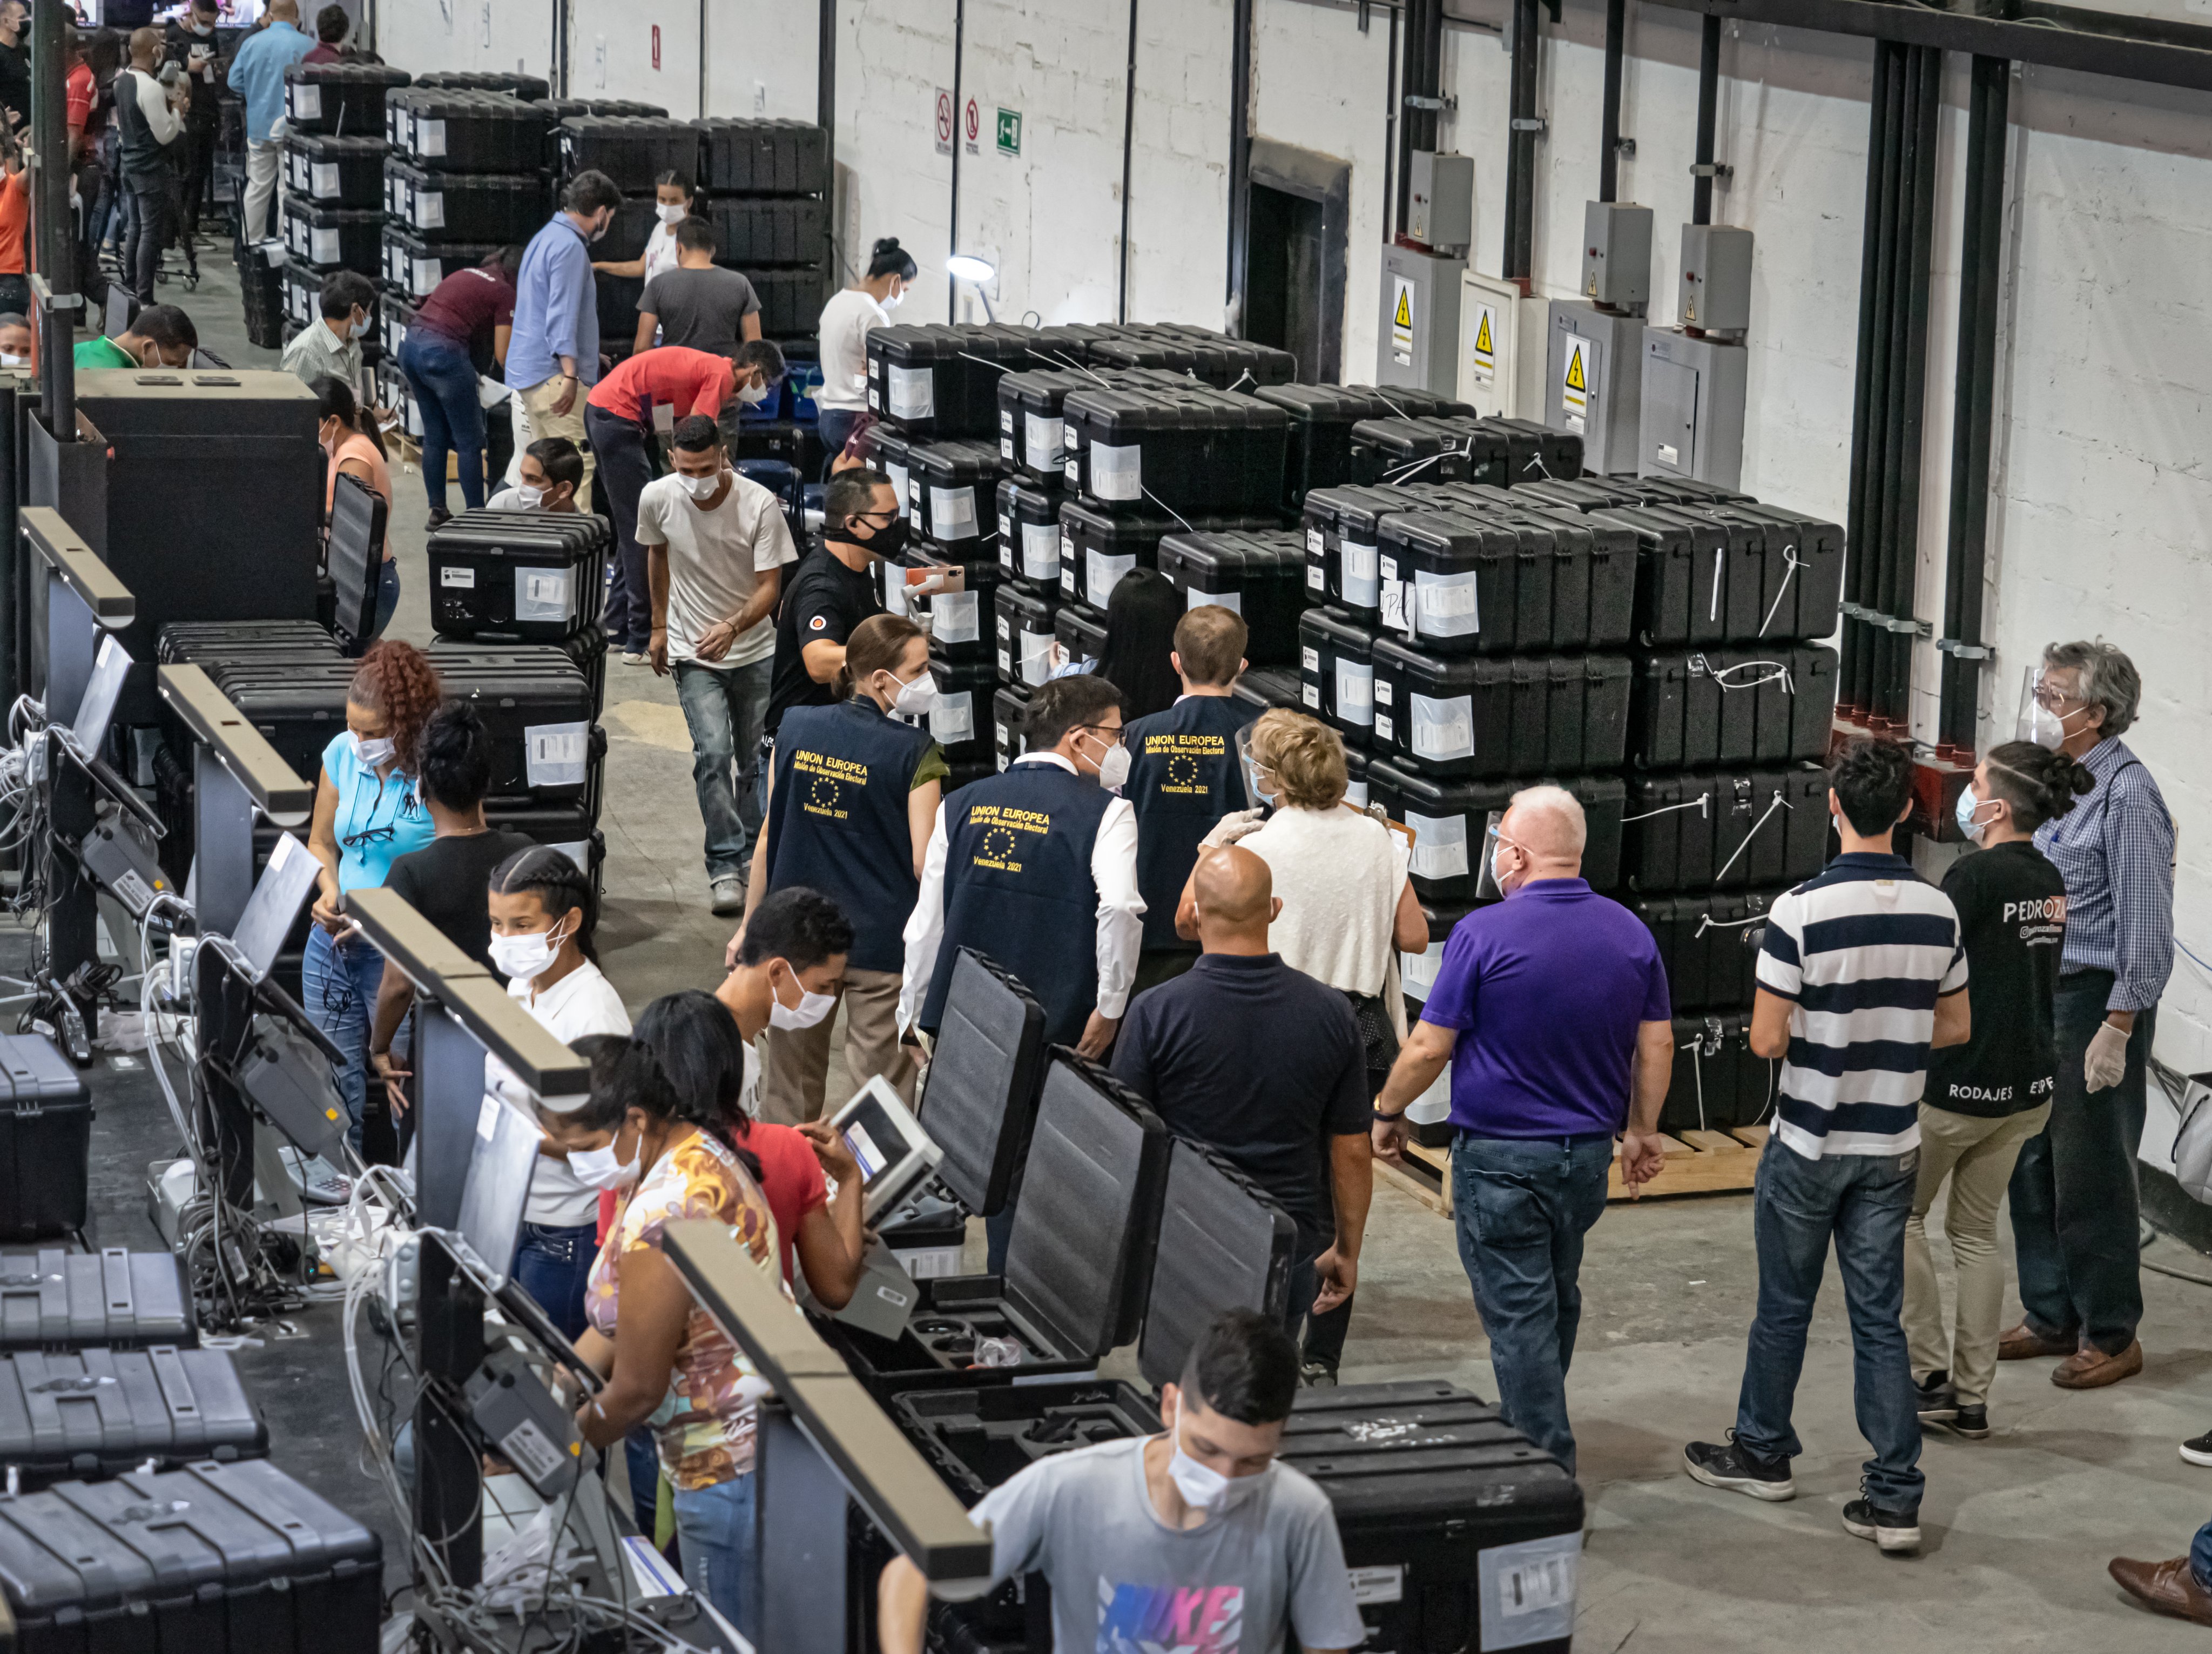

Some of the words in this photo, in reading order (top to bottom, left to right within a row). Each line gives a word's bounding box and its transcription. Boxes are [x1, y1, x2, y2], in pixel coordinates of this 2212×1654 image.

[1145, 735, 1175, 745] UNION
[1179, 736, 1224, 745] EUROPEA
[1146, 744, 1161, 754] Misión
[1171, 745, 1201, 754] Observación
[1203, 747, 1224, 755] Electoral
[796, 750, 823, 765] UNION
[826, 757, 867, 776] EUROPEA
[794, 761, 808, 771] Misión
[817, 766, 845, 779] Observación
[846, 773, 867, 785] Electoral
[1161, 784, 1192, 793] Venezuela
[1195, 785, 1208, 794] 2021
[804, 803, 832, 816] Venezuela
[835, 809, 847, 819] 2021
[971, 806, 1000, 816] UNION
[1003, 808, 1049, 825] EUROPEA
[992, 817, 1023, 829] Observación
[1024, 823, 1048, 834] Electoral
[974, 856, 1005, 869] Venezuela
[1007, 862, 1022, 872] 2021
[2003, 899, 2066, 922] PEDROZA
[1950, 1084, 2012, 1101] RODAJES
